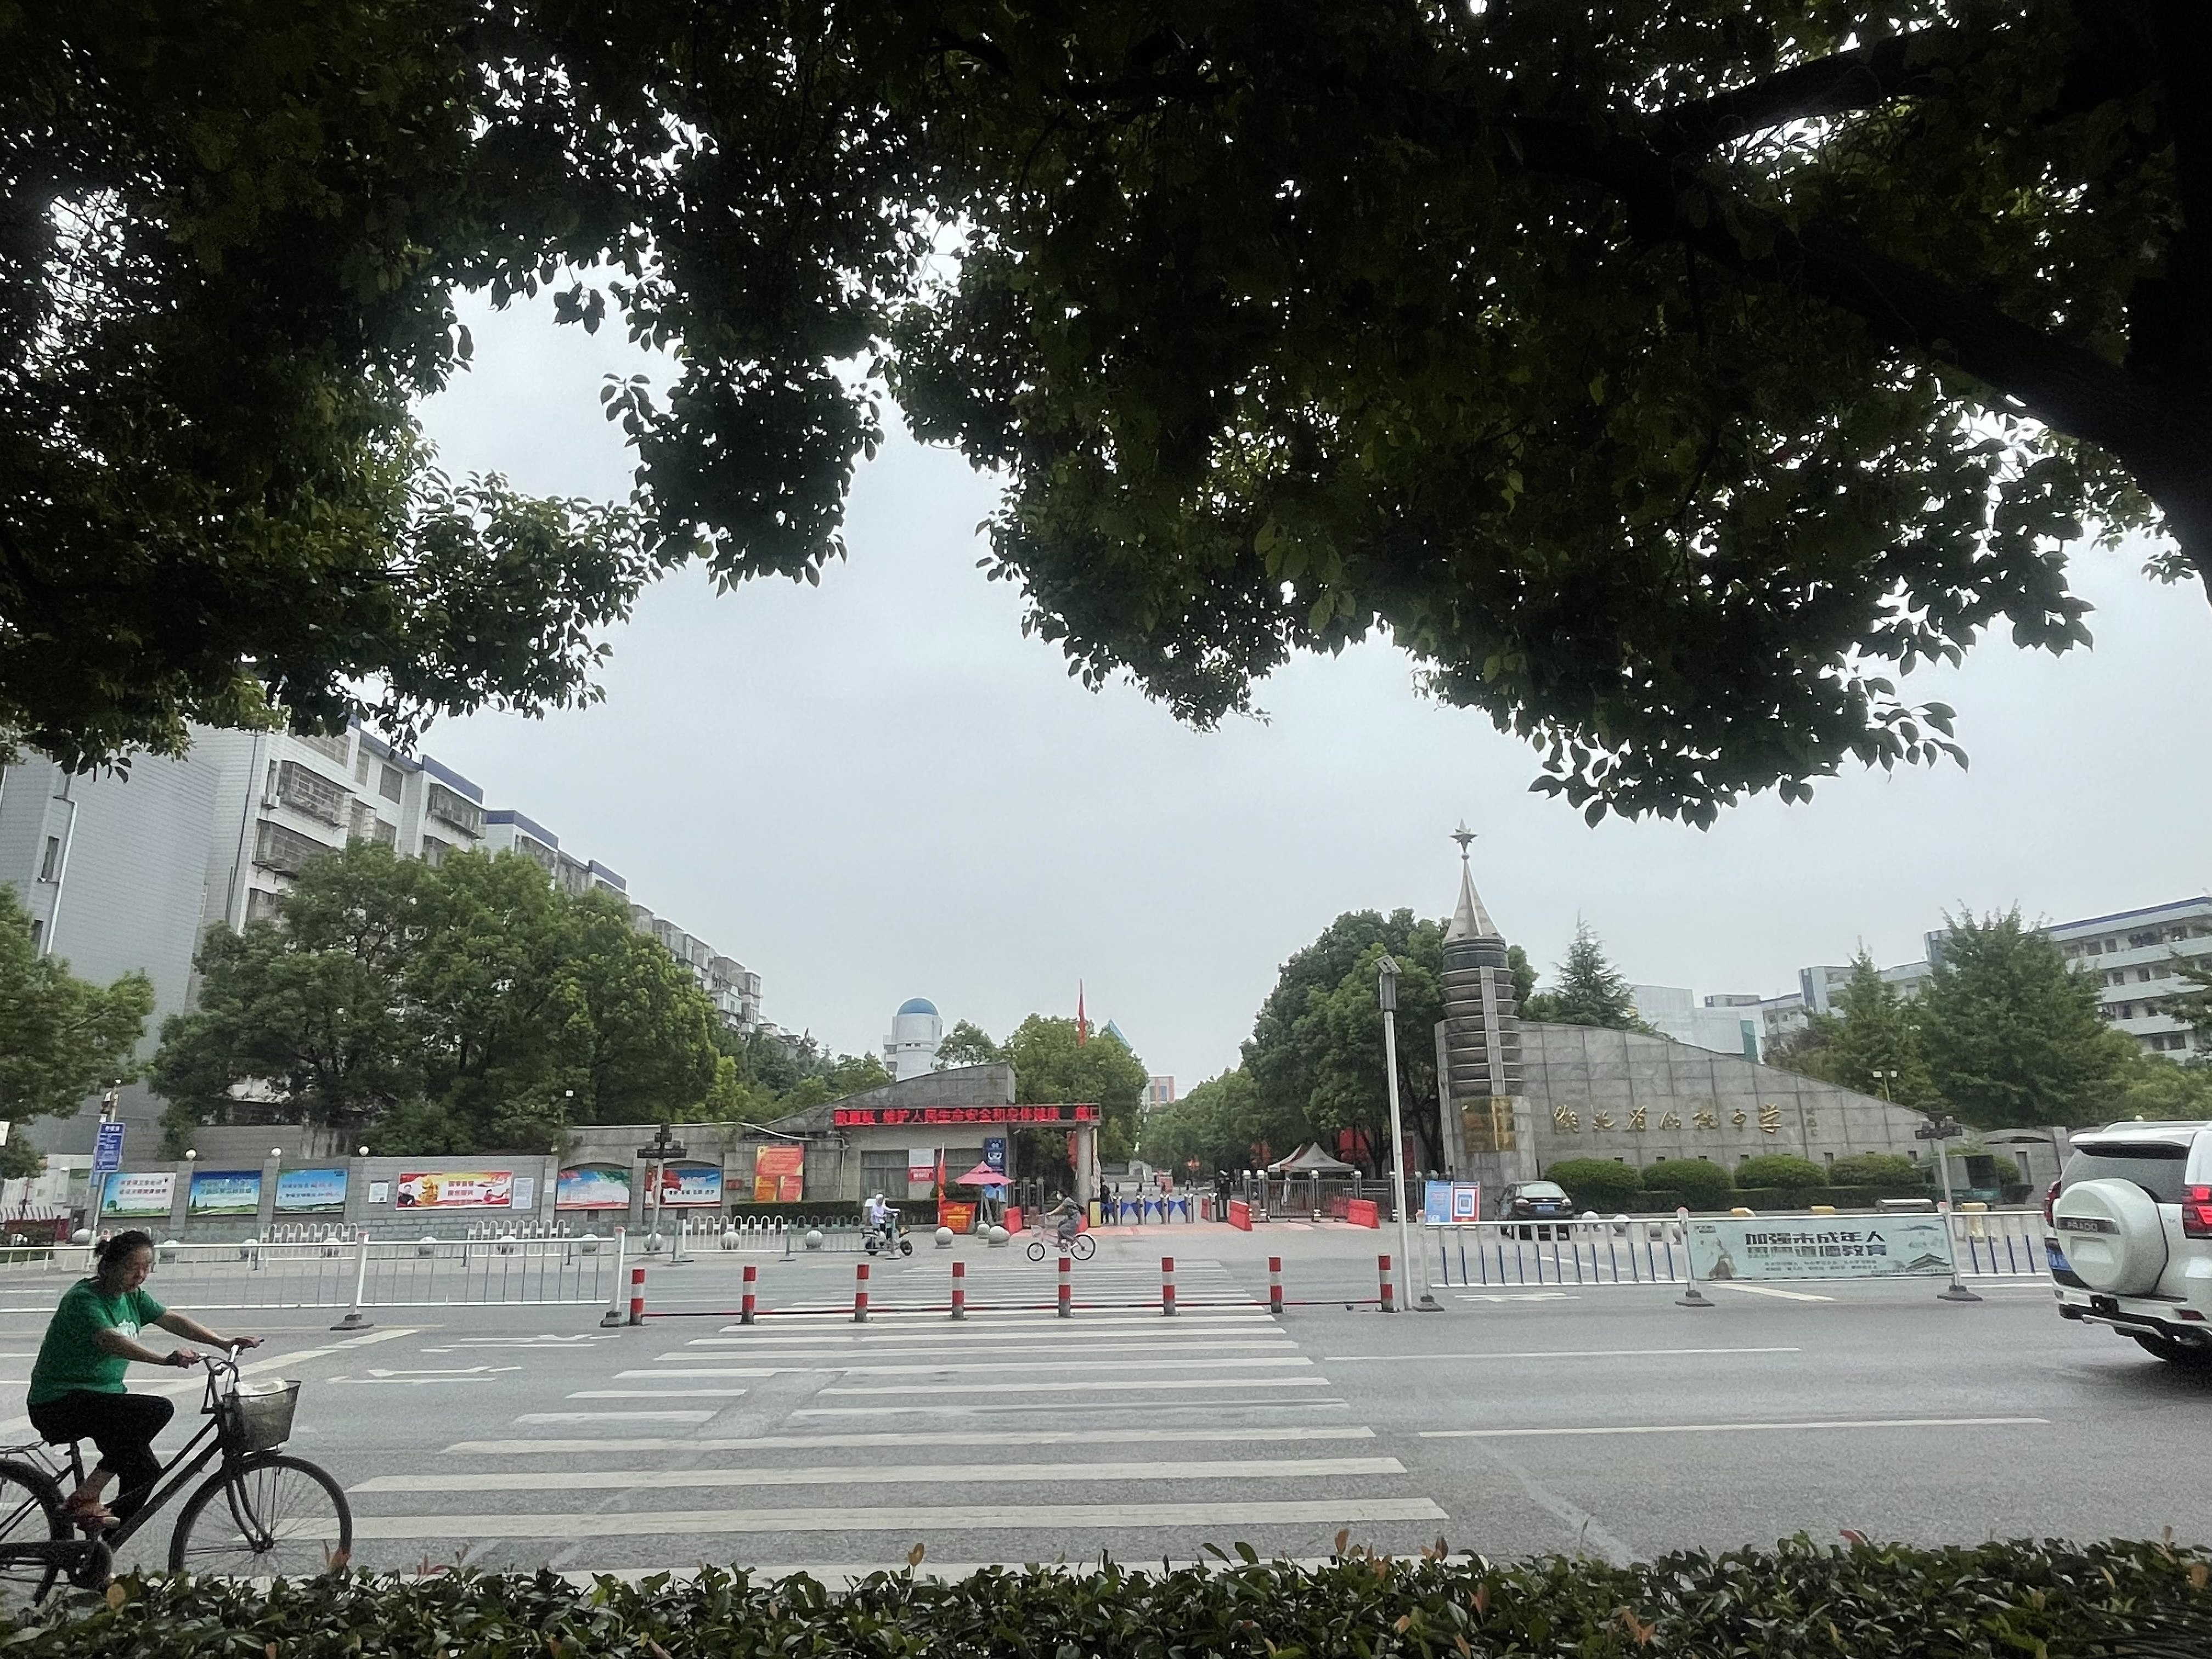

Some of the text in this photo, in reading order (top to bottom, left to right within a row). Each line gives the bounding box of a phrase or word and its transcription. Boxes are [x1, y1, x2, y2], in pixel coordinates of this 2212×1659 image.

[1554, 1104, 1782, 1135] 湖北省仙桃中学
[2067, 1221, 2098, 1232] PRADO
[1745, 1231, 1886, 1245] 加强未成年人
